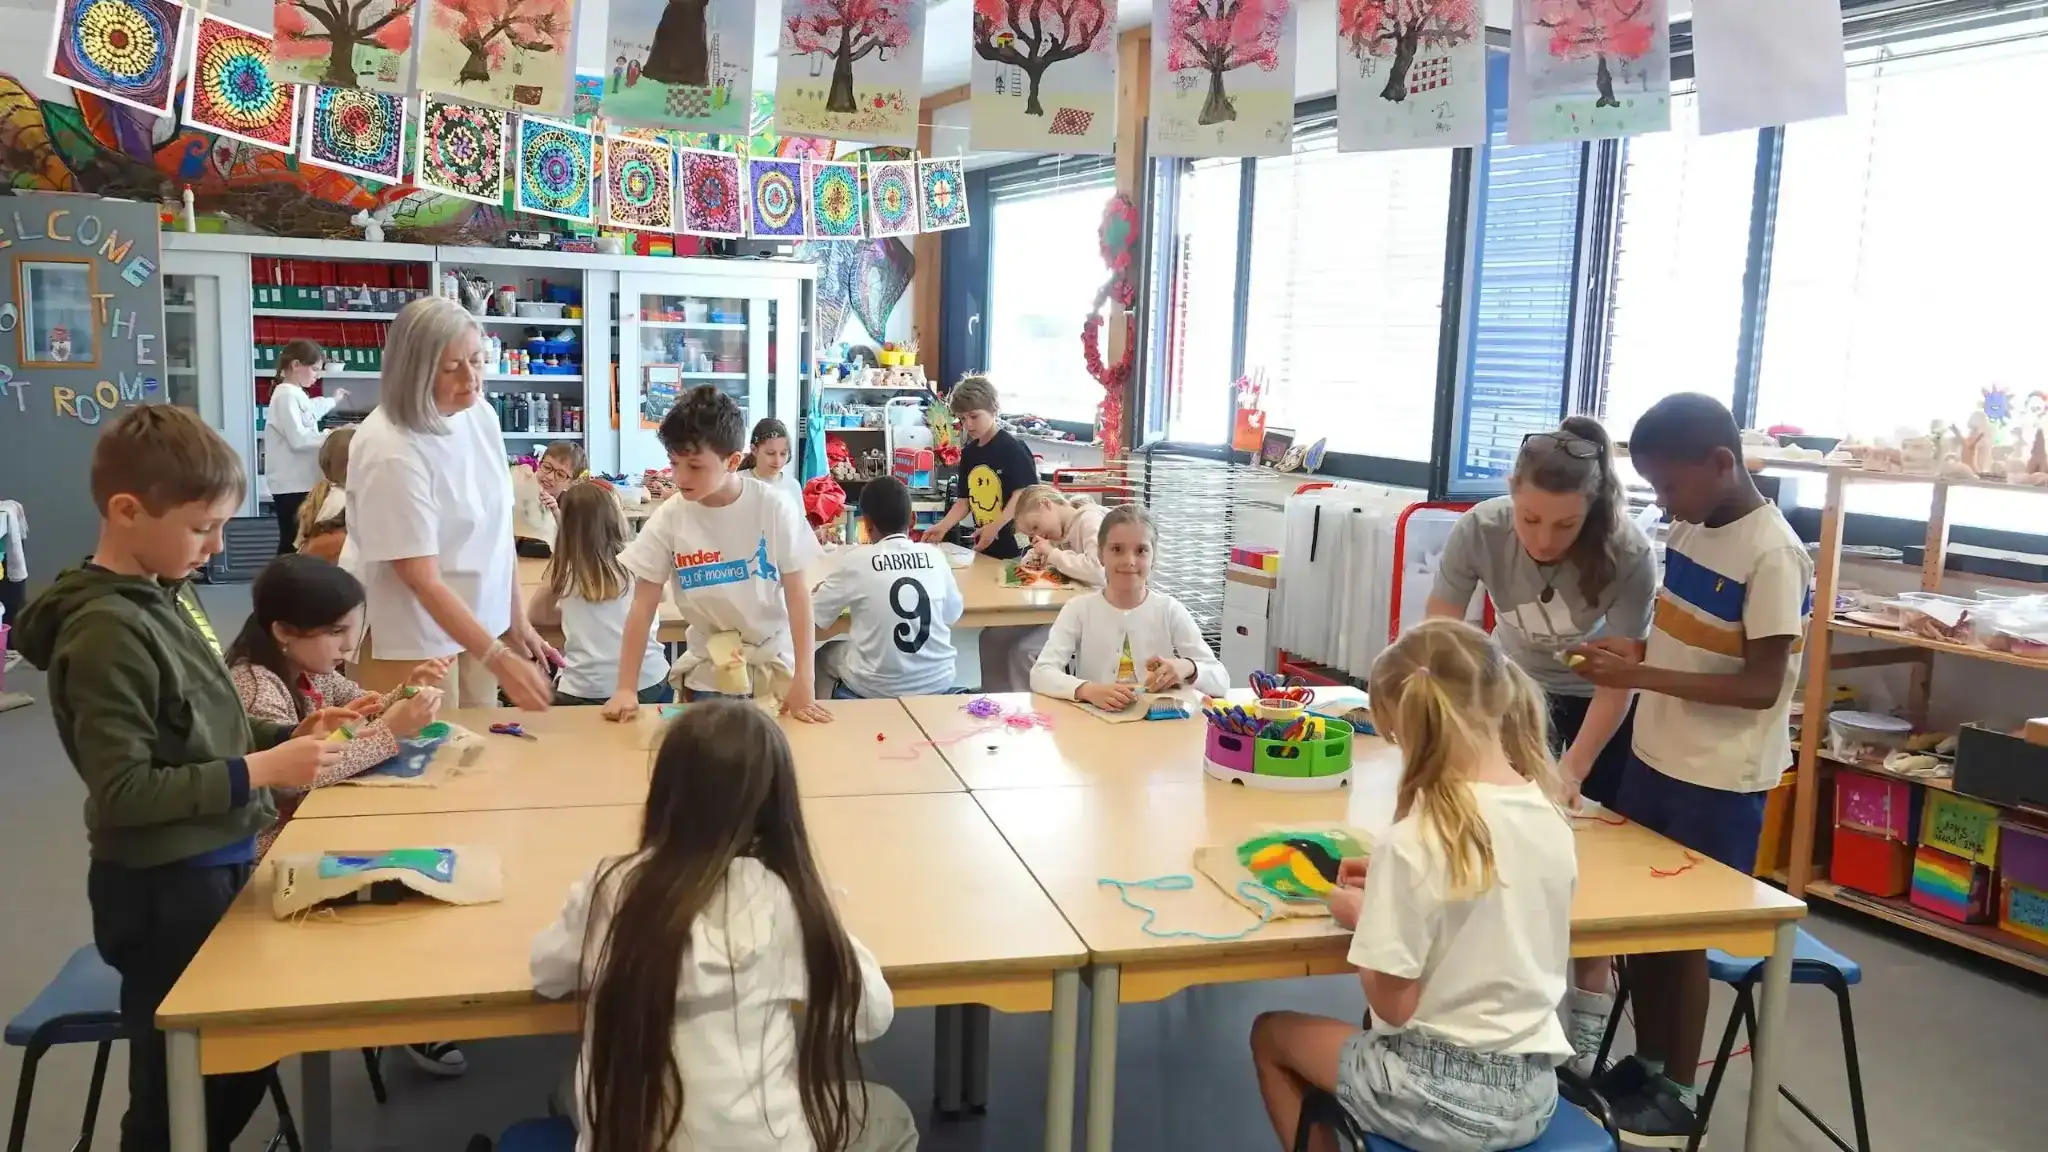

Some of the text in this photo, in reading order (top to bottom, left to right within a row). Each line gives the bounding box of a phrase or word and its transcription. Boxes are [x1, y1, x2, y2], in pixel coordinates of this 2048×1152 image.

[92, 293, 157, 365] THE
[53, 371, 144, 425] ROOM
[693, 569, 703, 583] of
[705, 566, 745, 582] moving
[871, 552, 934, 572] GABRIEL
[889, 576, 931, 654] 9
